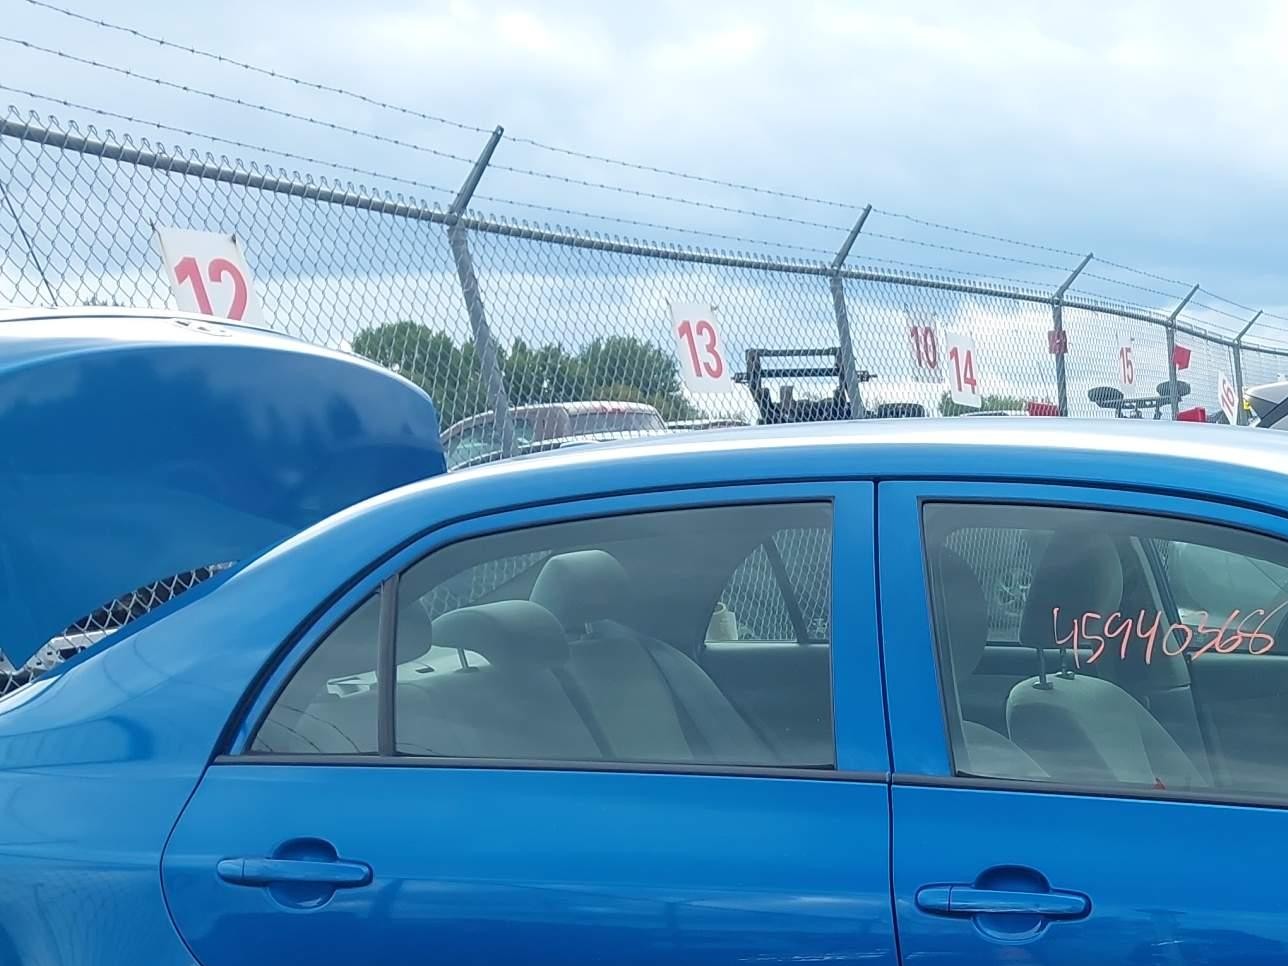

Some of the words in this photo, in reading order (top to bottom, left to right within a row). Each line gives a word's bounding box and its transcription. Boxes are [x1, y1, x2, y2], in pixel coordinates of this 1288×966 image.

[174, 255, 248, 321] 12
[677, 319, 723, 379] 13
[910, 326, 938, 369] 10
[949, 346, 977, 395] 14
[1119, 346, 1134, 385] 15
